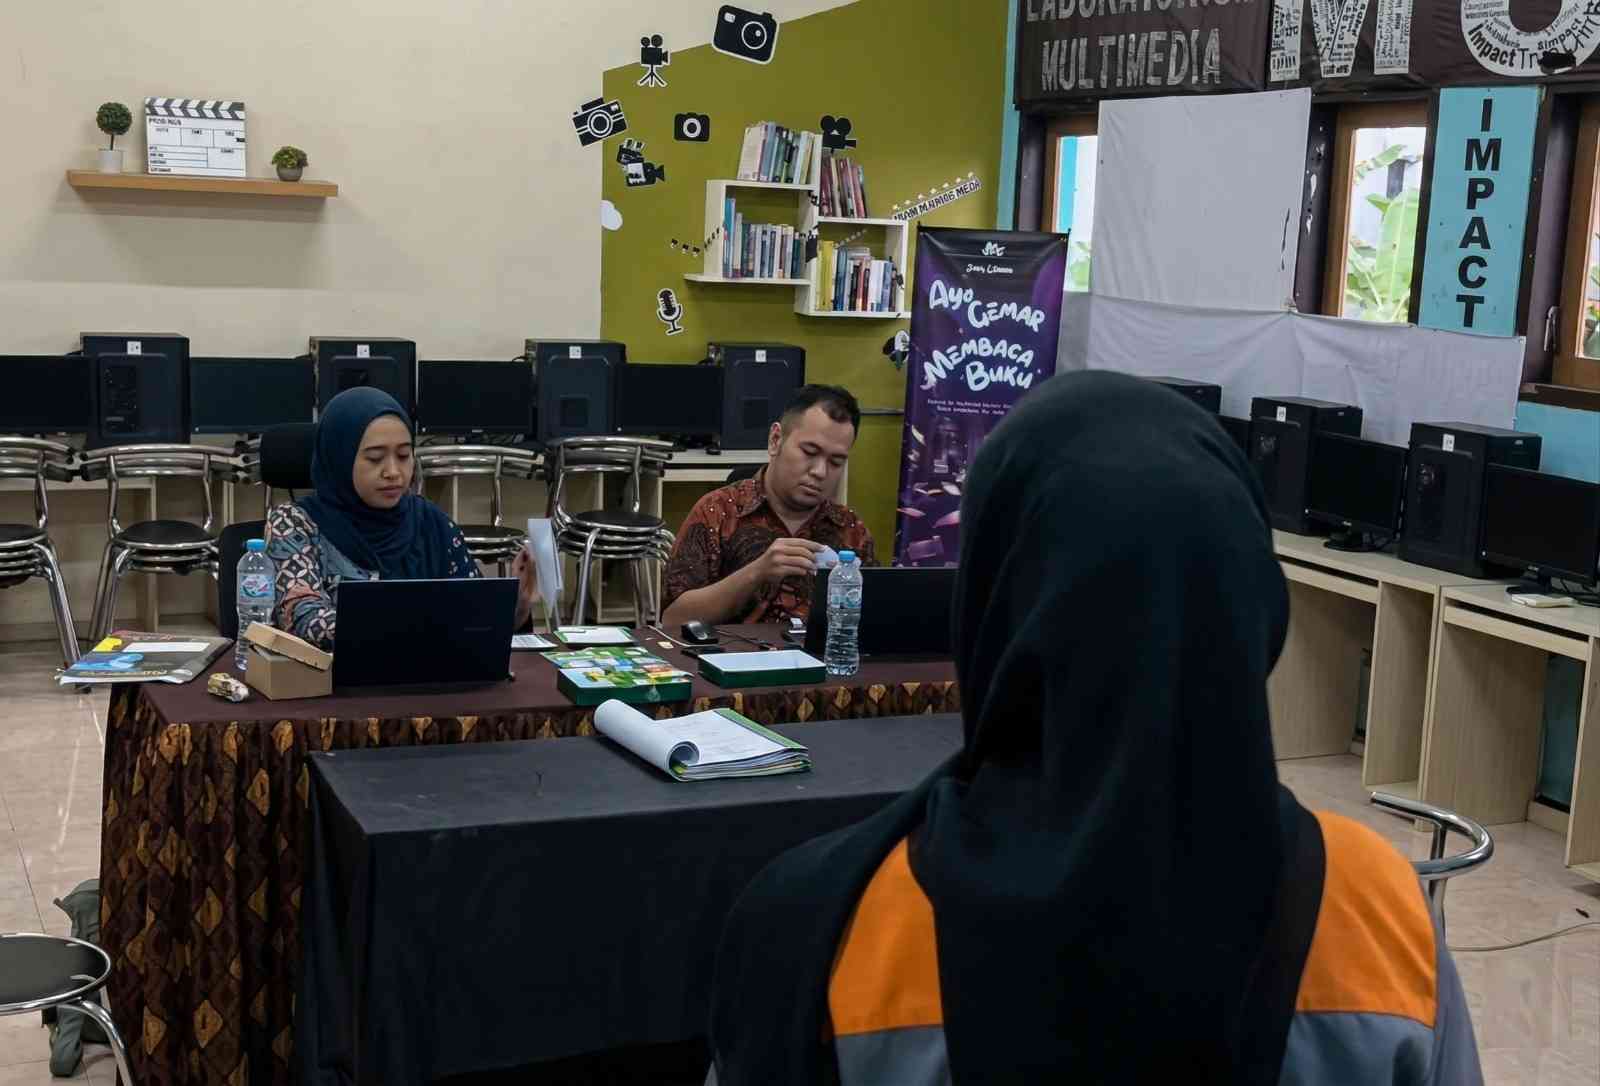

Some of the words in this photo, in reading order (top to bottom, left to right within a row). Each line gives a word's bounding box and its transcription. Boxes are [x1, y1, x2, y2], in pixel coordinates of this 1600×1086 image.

[1041, 28, 1222, 91] MULTIMEDIA
[1468, 23, 1517, 68] Impact
[1456, 98, 1502, 328] IMPACT
[929, 279, 974, 311] Ayo
[967, 299, 1045, 333] GEMAR
[920, 337, 1034, 390] MEMBACA
